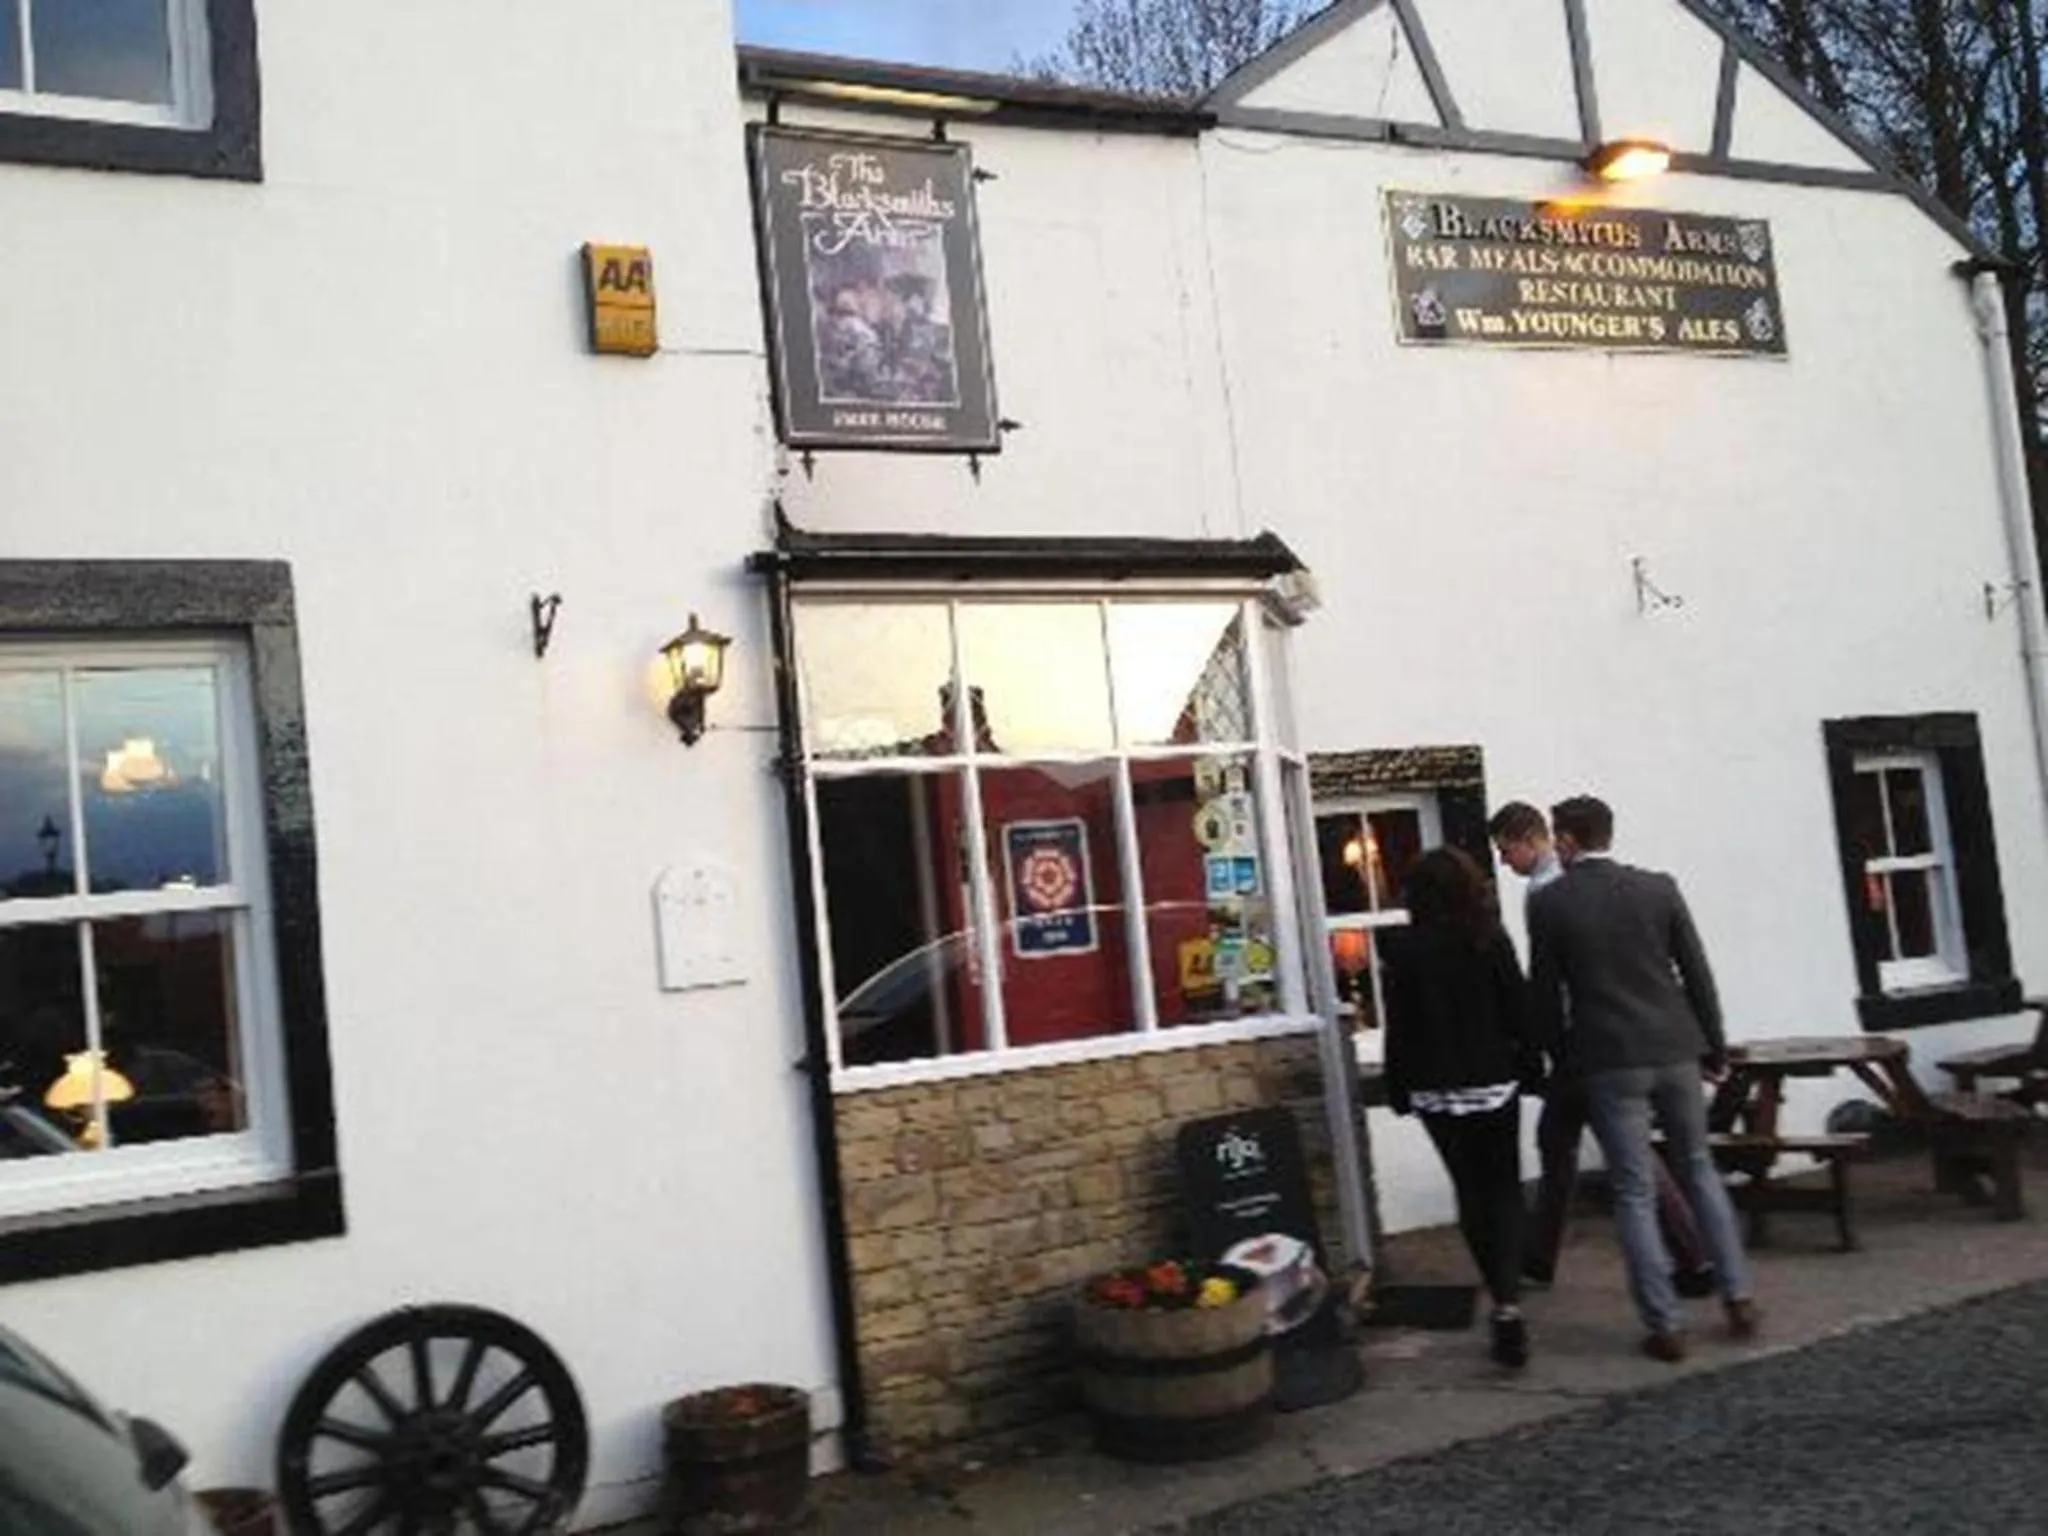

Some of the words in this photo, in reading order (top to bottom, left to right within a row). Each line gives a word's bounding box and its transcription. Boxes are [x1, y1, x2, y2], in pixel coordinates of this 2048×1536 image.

[828, 152, 886, 185] The
[598, 258, 651, 293] AA
[1517, 278, 1677, 312] RESTAURANT
[1678, 316, 1741, 345] ALES
